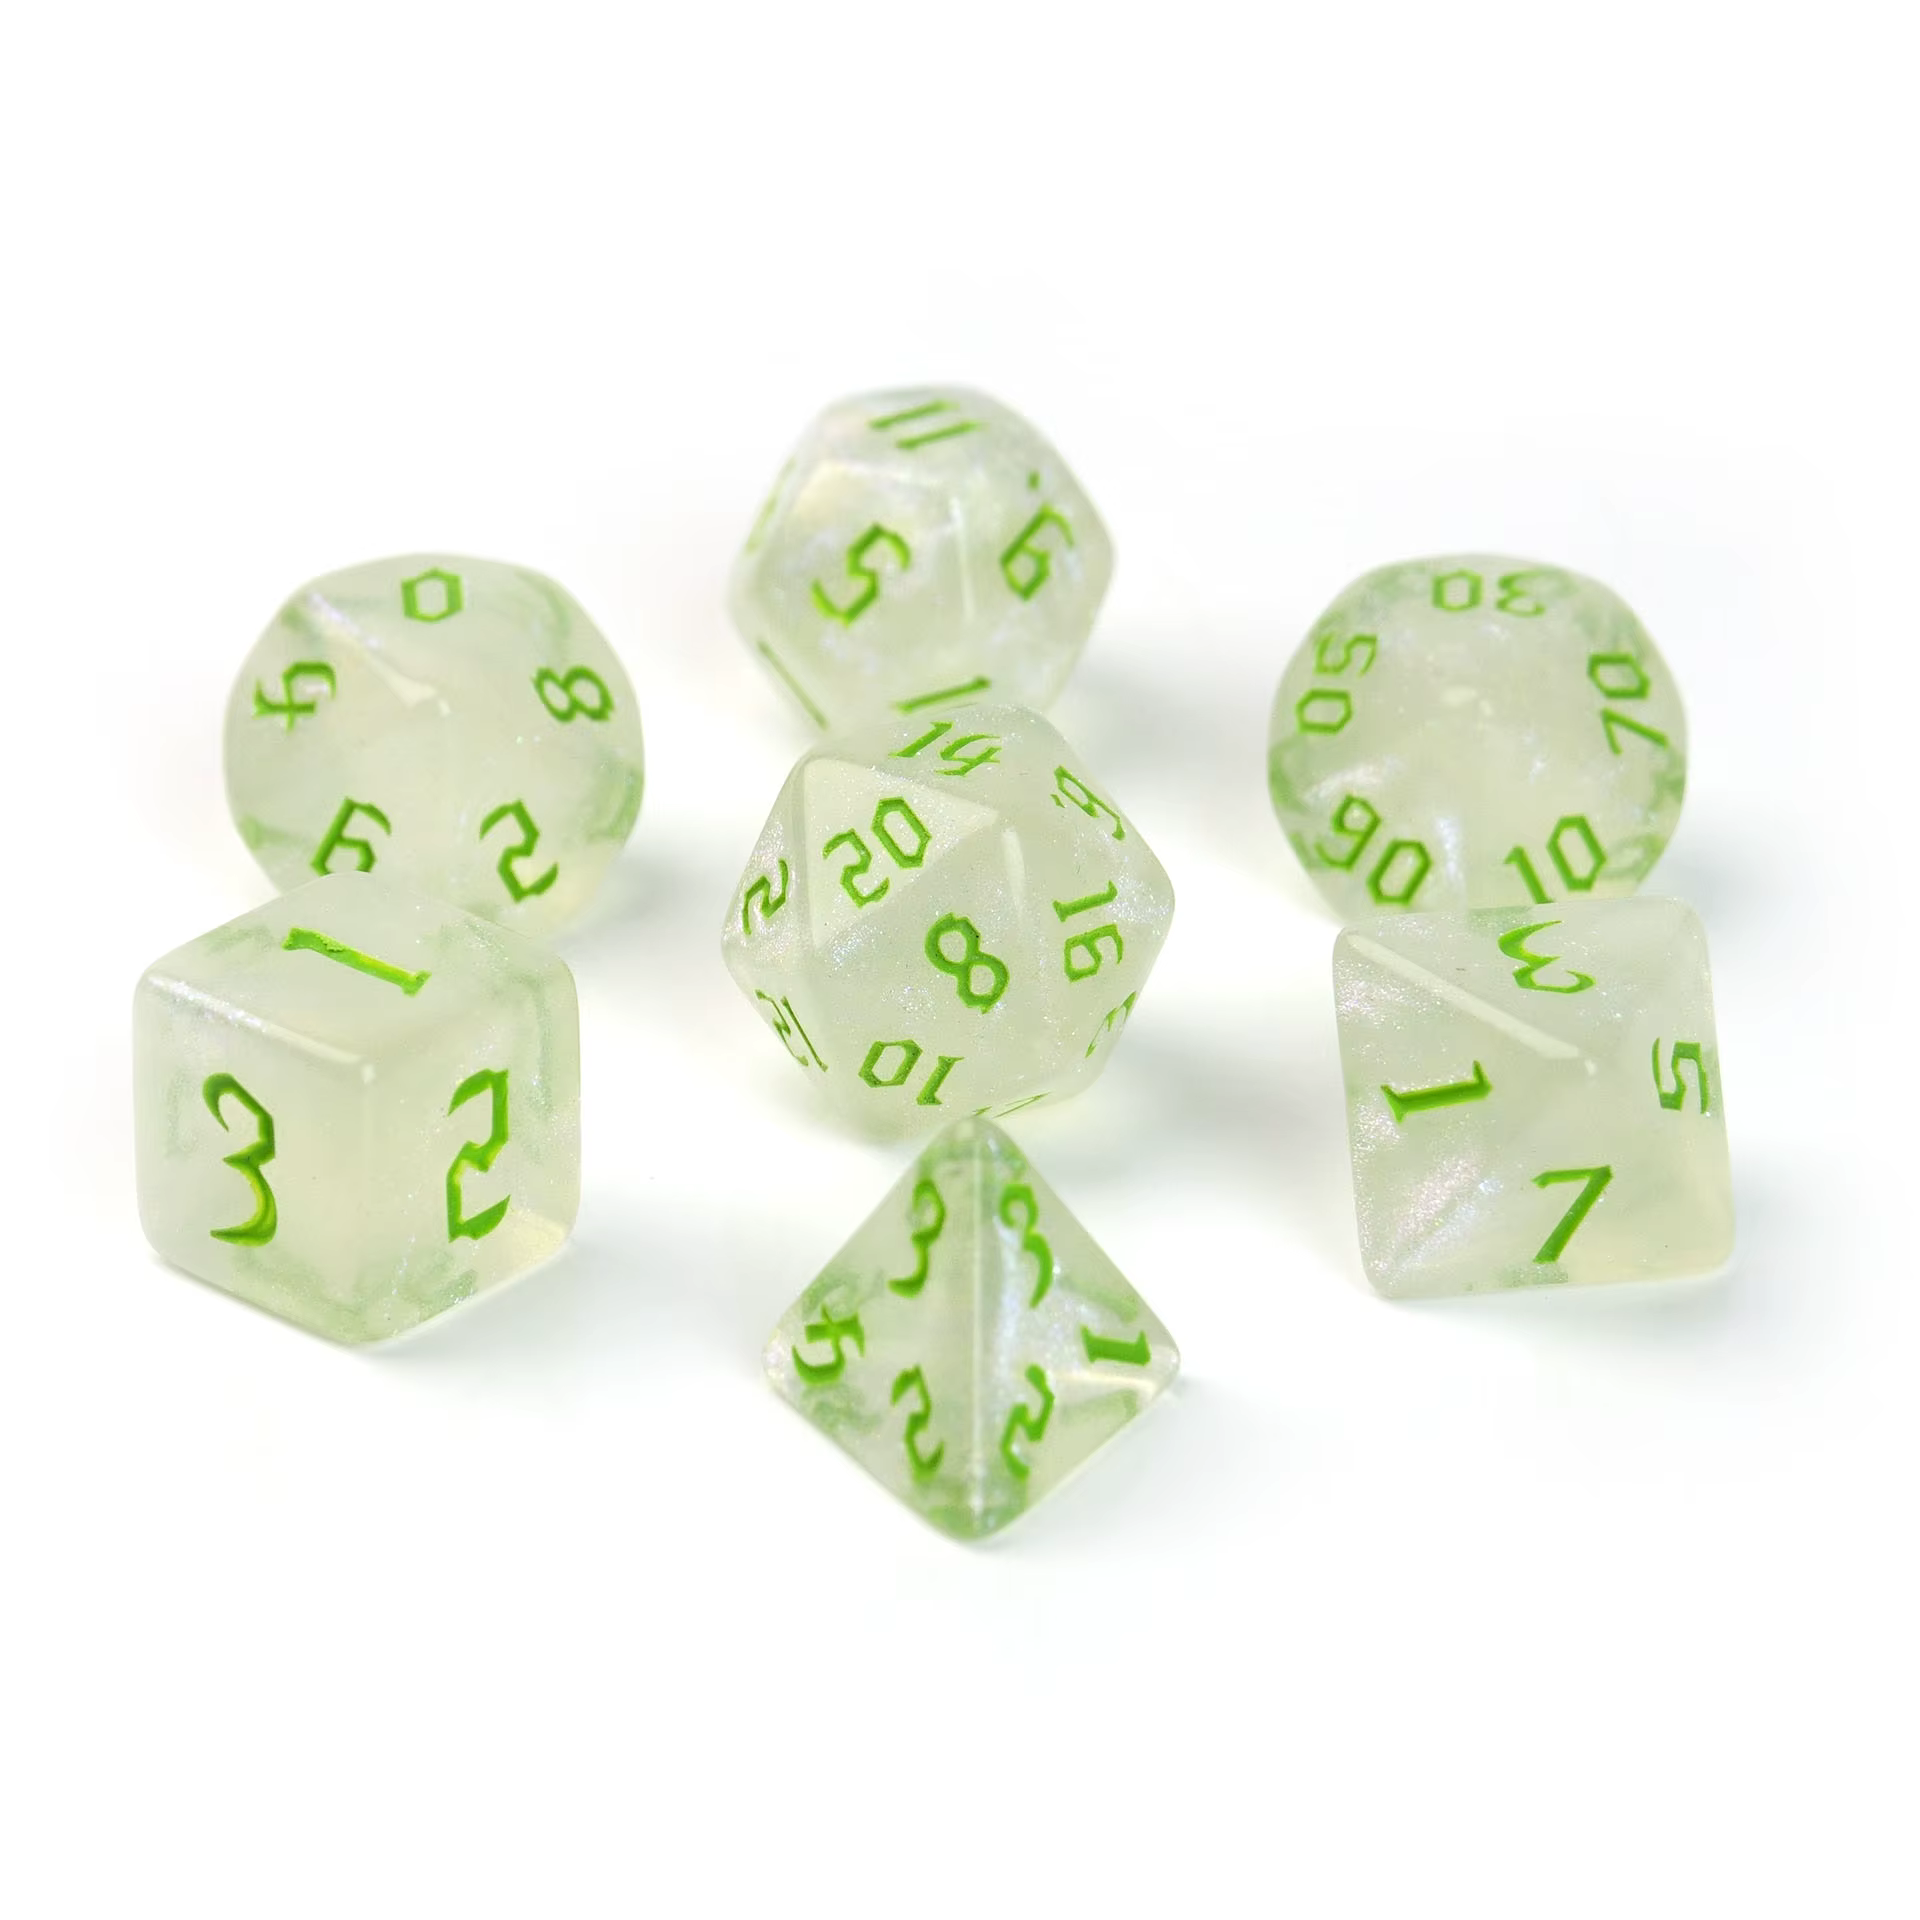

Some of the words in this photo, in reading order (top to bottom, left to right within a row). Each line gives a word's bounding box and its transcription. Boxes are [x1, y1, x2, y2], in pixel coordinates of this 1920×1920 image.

[401, 568, 463, 624] 0
[811, 523, 913, 630] 5
[252, 659, 337, 731] 4
[533, 664, 615, 724] 8
[1586, 651, 1670, 756] 70
[479, 798, 560, 903] 2
[737, 857, 790, 936] 2
[822, 797, 933, 909] 20
[281, 927, 433, 998] 1
[923, 911, 1012, 1015] 8
[1498, 919, 1597, 995] 3
[856, 1038, 966, 1106] 10
[1379, 1060, 1494, 1125] 1
[202, 1072, 279, 1250] 3
[444, 1066, 511, 1244] 2
[887, 1178, 947, 1299] 3
[998, 1182, 1055, 1309] 3
[1530, 1164, 1615, 1266] 7
[791, 1302, 866, 1387] 4
[1079, 1324, 1152, 1368] 1
[891, 1364, 945, 1486] 2
